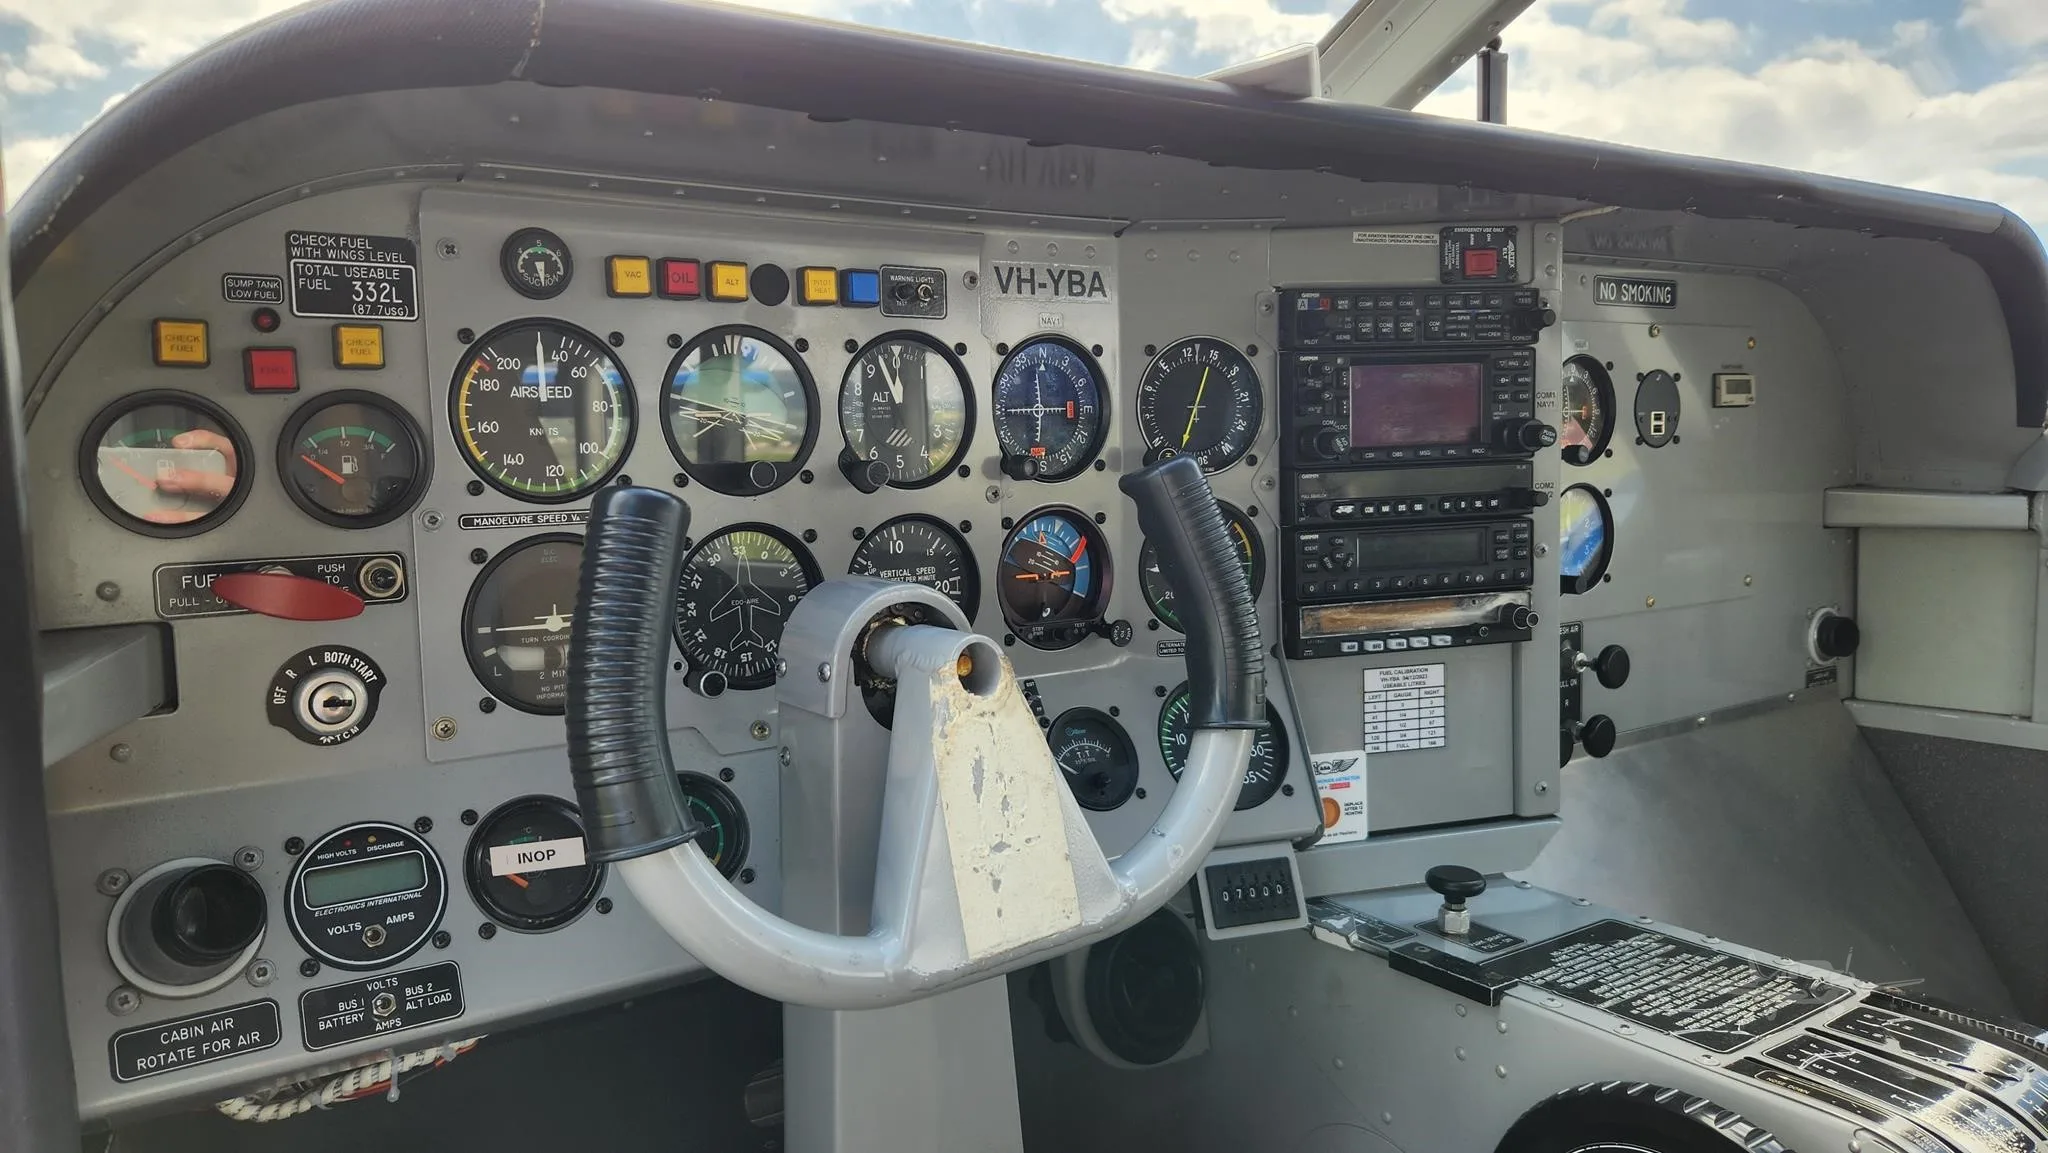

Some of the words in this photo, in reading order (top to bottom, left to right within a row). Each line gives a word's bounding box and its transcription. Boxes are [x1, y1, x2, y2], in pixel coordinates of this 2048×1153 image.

[290, 234, 336, 246] CHECK
[340, 238, 372, 250] FUEL
[291, 247, 322, 259] WITH
[328, 249, 365, 261] WINGS
[370, 252, 406, 263] LEVEL
[298, 264, 338, 277] TOTAL
[344, 267, 400, 279] USEABLE
[624, 271, 641, 279] VAC
[228, 278, 254, 288] SUMP
[256, 280, 280, 289] TANK
[523, 272, 560, 287] SUCION
[671, 273, 694, 284] OIL
[724, 278, 739, 286] ALT
[994, 266, 1107, 298] VH-YBA
[231, 290, 251, 299] LOW
[254, 290, 277, 300] FUEL
[299, 278, 331, 291] FUEL
[352, 281, 402, 303] 332L
[1600, 281, 1616, 300] NO
[1621, 284, 1672, 303] SMOKING
[352, 304, 408, 317] (87.7USG)
[165, 334, 201, 344] CHECK
[346, 338, 377, 347] CHECK
[170, 344, 196, 353] FUEL
[350, 347, 372, 356] FUEL
[1039, 348, 1046, 357] N
[1182, 348, 1192, 357] 12
[552, 351, 568, 362] 40
[1014, 353, 1026, 367] 33
[1062, 356, 1069, 366] 3
[1209, 350, 1219, 360] 15
[496, 358, 520, 370] 200
[571, 367, 587, 378] 60
[867, 365, 875, 378] 9
[480, 380, 499, 391] 180
[854, 383, 862, 396] 8
[510, 386, 572, 398] AIRSEED
[872, 392, 889, 402] ALT
[1240, 392, 1249, 402] 21
[592, 401, 608, 412] 80
[478, 421, 499, 433] 160
[934, 424, 941, 438] 3
[857, 429, 864, 442] 7
[1077, 430, 1088, 443] 12
[580, 442, 599, 454] 100
[870, 446, 878, 460] 6
[921, 445, 928, 458] 4
[503, 454, 524, 465] 140
[896, 455, 904, 468] 5
[1060, 452, 1072, 464] 15
[546, 465, 564, 477] 120
[474, 515, 533, 526] MANOEUVRE
[538, 514, 567, 523] SPEED
[733, 546, 746, 556] 33
[890, 540, 903, 554] 10
[926, 548, 934, 556] 15
[707, 553, 721, 566] 30
[317, 564, 345, 573] PUSH
[880, 569, 910, 578] VERTICAL
[916, 566, 936, 574] SPEED
[182, 574, 222, 589] FUE
[325, 575, 340, 584] TO
[692, 574, 702, 589] 27
[934, 580, 950, 592] 20
[170, 597, 200, 608] PULL
[688, 602, 696, 617] 24
[694, 628, 708, 642] 21
[764, 640, 777, 652] 12
[324, 652, 350, 665] BOTH
[714, 647, 728, 659] 18
[740, 652, 752, 662] 15
[309, 655, 317, 666] L
[286, 669, 297, 680] R
[350, 657, 378, 683] START
[273, 687, 288, 704] OFF
[335, 726, 360, 742] TCM
[1176, 734, 1187, 745] 10
[367, 840, 404, 852] DISCHARGE
[317, 852, 335, 860] HIGH
[337, 849, 357, 858] VOLTS
[517, 849, 556, 864] INOP
[314, 902, 366, 917] ELECTRONICS
[367, 892, 422, 908] INTERNATIONAL
[386, 911, 415, 926] AMPS
[327, 922, 362, 936] VOLTS
[366, 978, 399, 992] VOLTS
[405, 985, 425, 997] BUS
[427, 984, 433, 992] 2
[338, 1000, 358, 1012] BUS
[405, 999, 425, 1011] ALT
[428, 993, 452, 1006] LOAD
[318, 1012, 365, 1031] BATTERY
[375, 1018, 402, 1032] AMPS
[160, 1025, 205, 1045] CABIN
[210, 1018, 235, 1033] AIR
[137, 1048, 197, 1071] ROTATE
[202, 1039, 232, 1056] FOR
[237, 1031, 261, 1048] AIR
[1765, 1077, 1785, 1088] NOSE
[1786, 1083, 1810, 1095] DOWN
